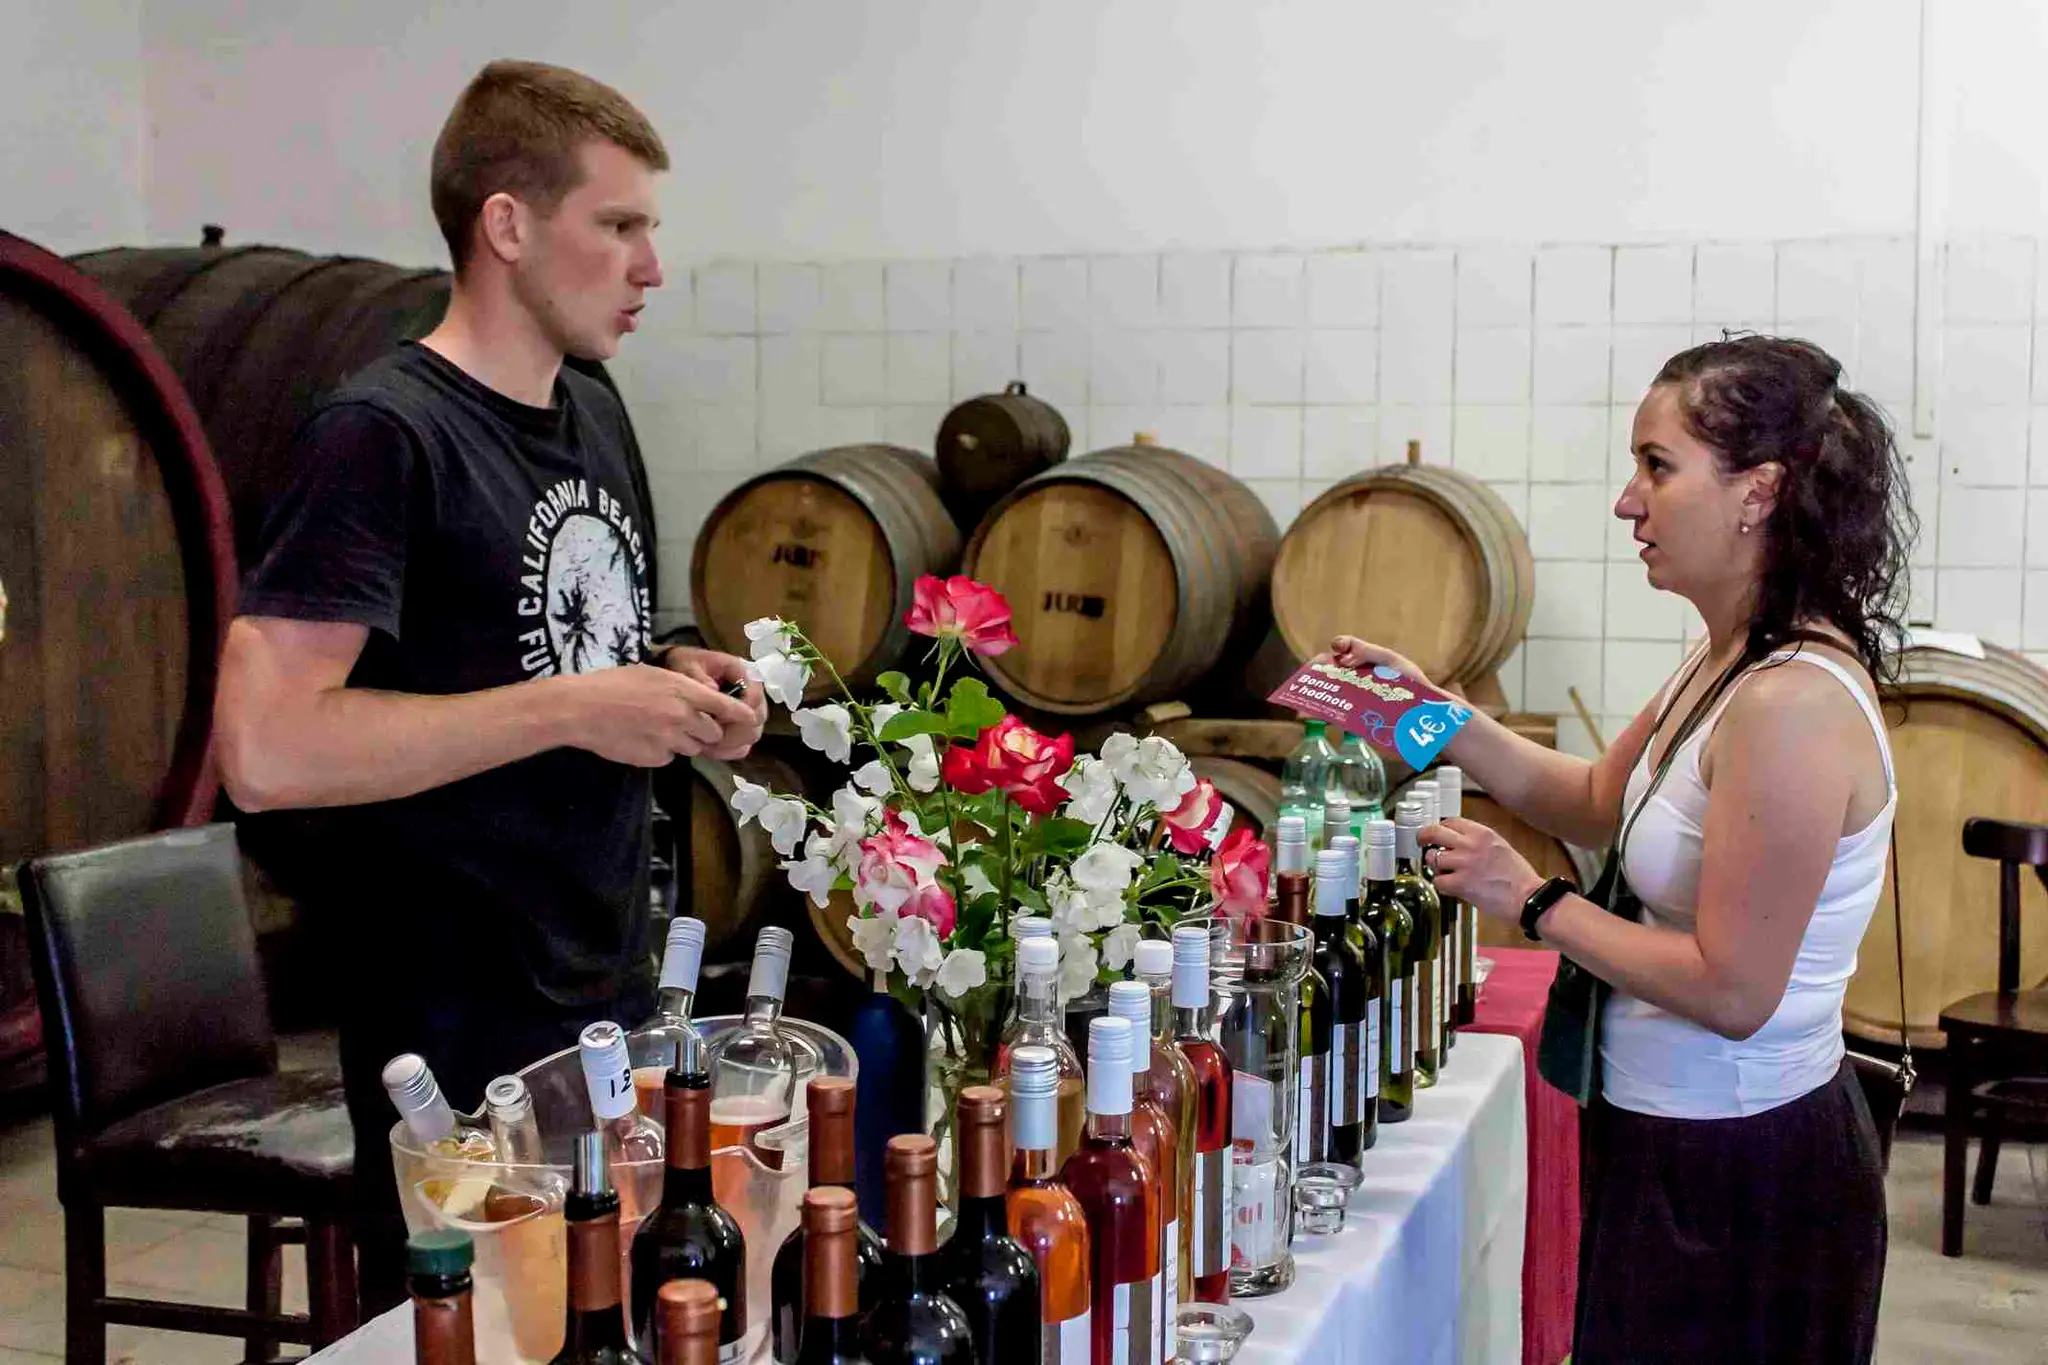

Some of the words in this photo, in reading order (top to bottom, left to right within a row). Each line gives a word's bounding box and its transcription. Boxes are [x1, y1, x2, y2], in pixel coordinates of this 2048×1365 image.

[518, 479, 589, 617] CALIFORNIA
[598, 488, 646, 575] BEACH
[1289, 683, 1297, 691] v
[1298, 685, 1354, 711] hodnote
[1297, 674, 1342, 693] Bonus
[1409, 715, 1446, 747] 4€
